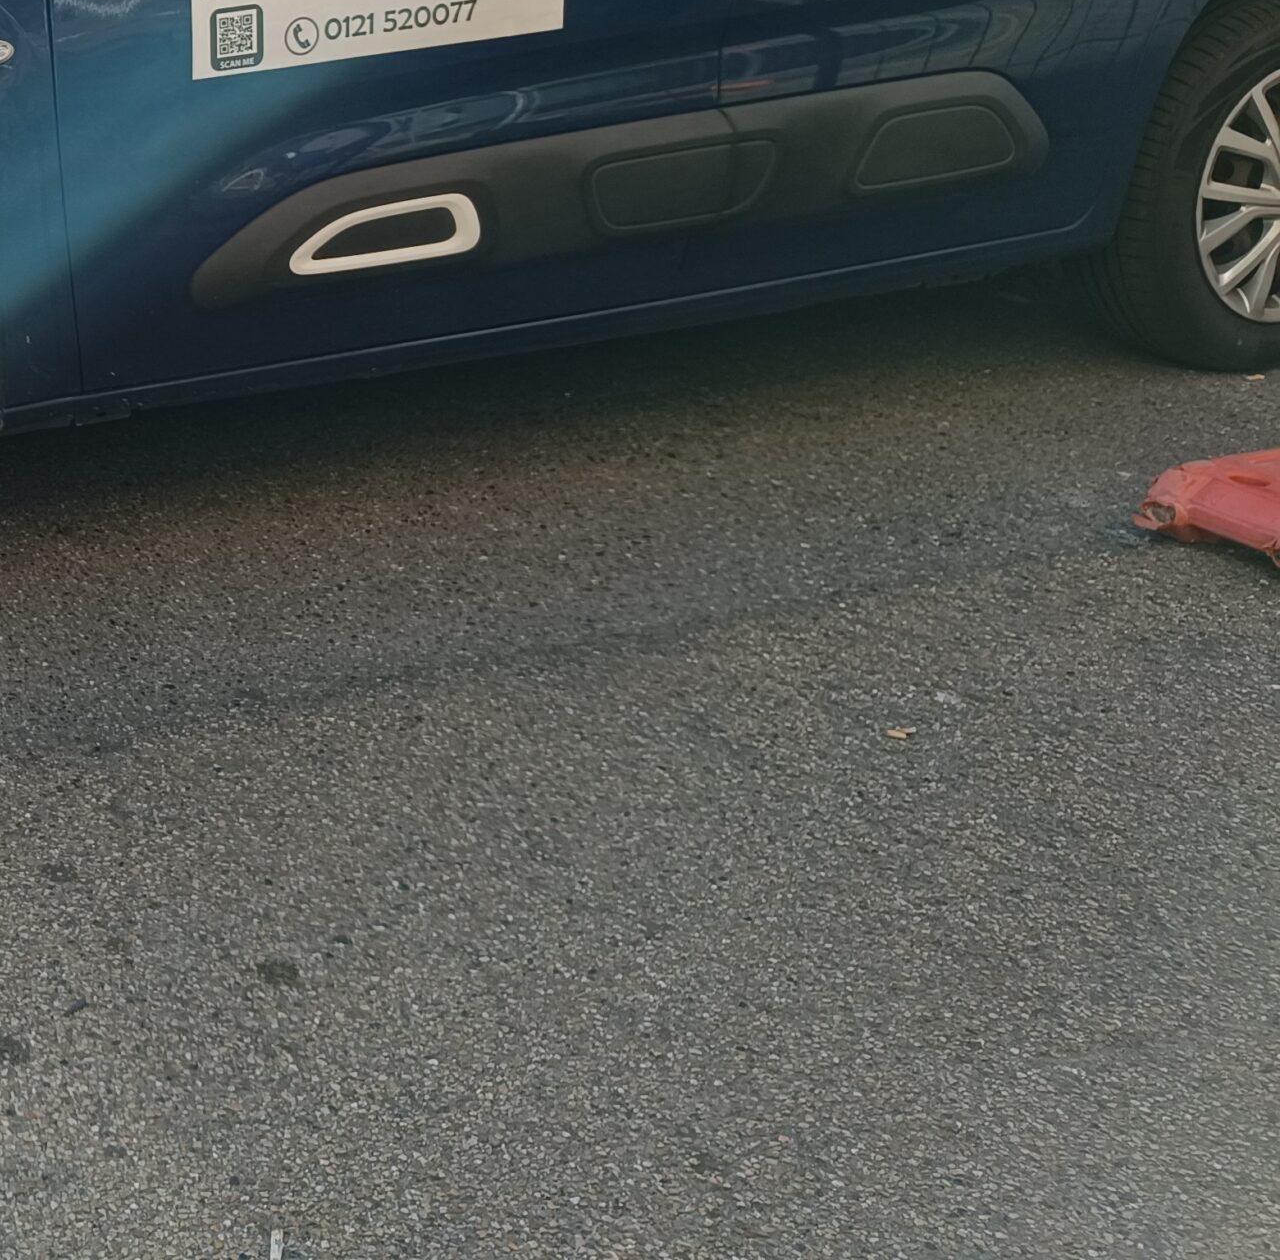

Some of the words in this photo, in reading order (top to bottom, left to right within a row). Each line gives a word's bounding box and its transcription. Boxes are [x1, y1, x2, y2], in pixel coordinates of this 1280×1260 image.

[325, 13, 375, 40] 0121
[383, 0, 477, 33] 520077
[220, 59, 241, 69] SCAN
[243, 57, 255, 66] ME
